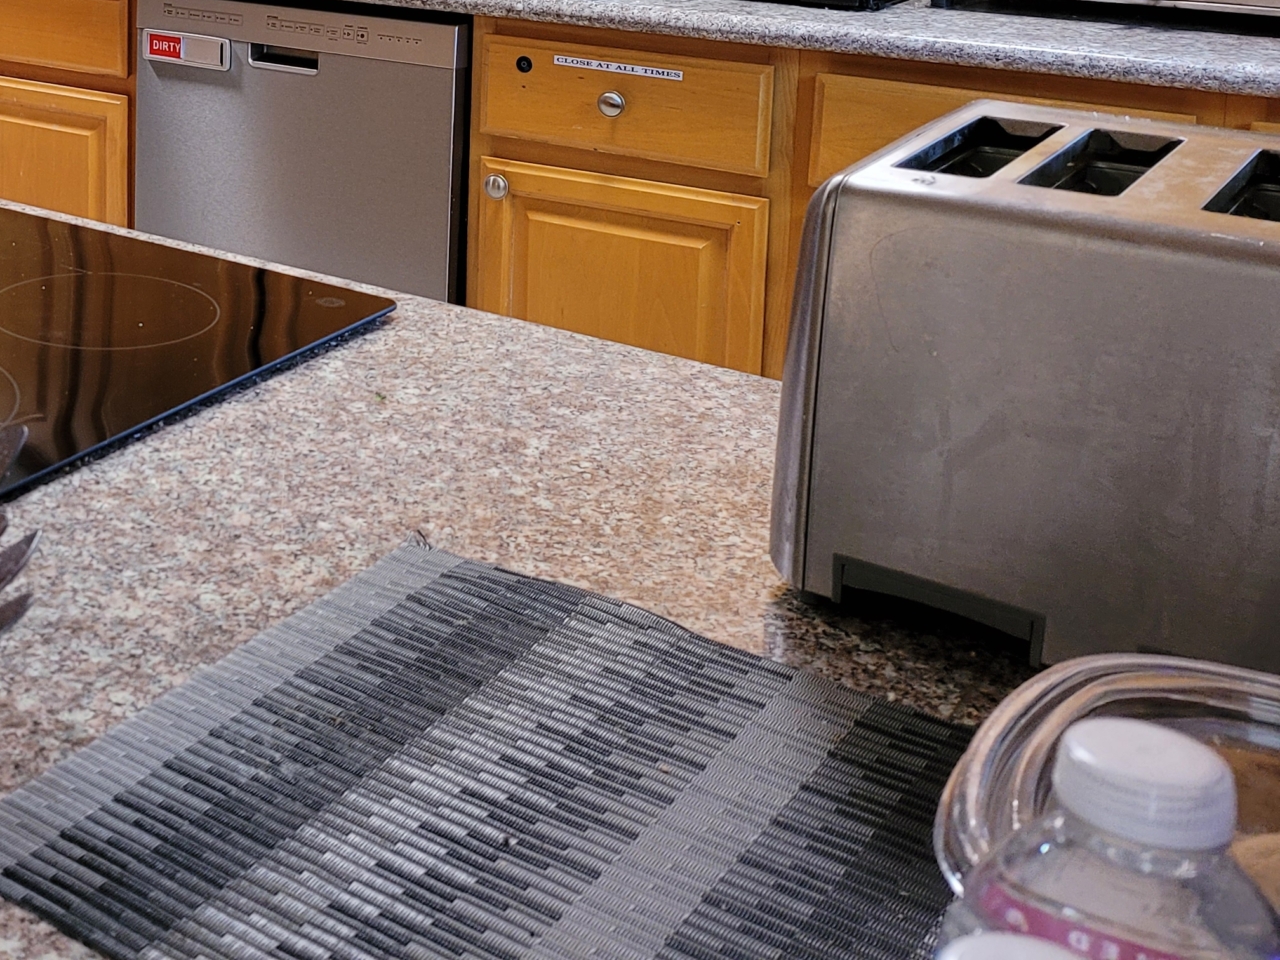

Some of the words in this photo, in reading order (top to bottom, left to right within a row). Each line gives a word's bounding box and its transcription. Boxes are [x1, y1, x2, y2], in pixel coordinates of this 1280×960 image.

[152, 40, 181, 53] DIRTY
[556, 57, 593, 66] CLOSE
[615, 64, 638, 72] ALL
[641, 68, 681, 78] TIMES
